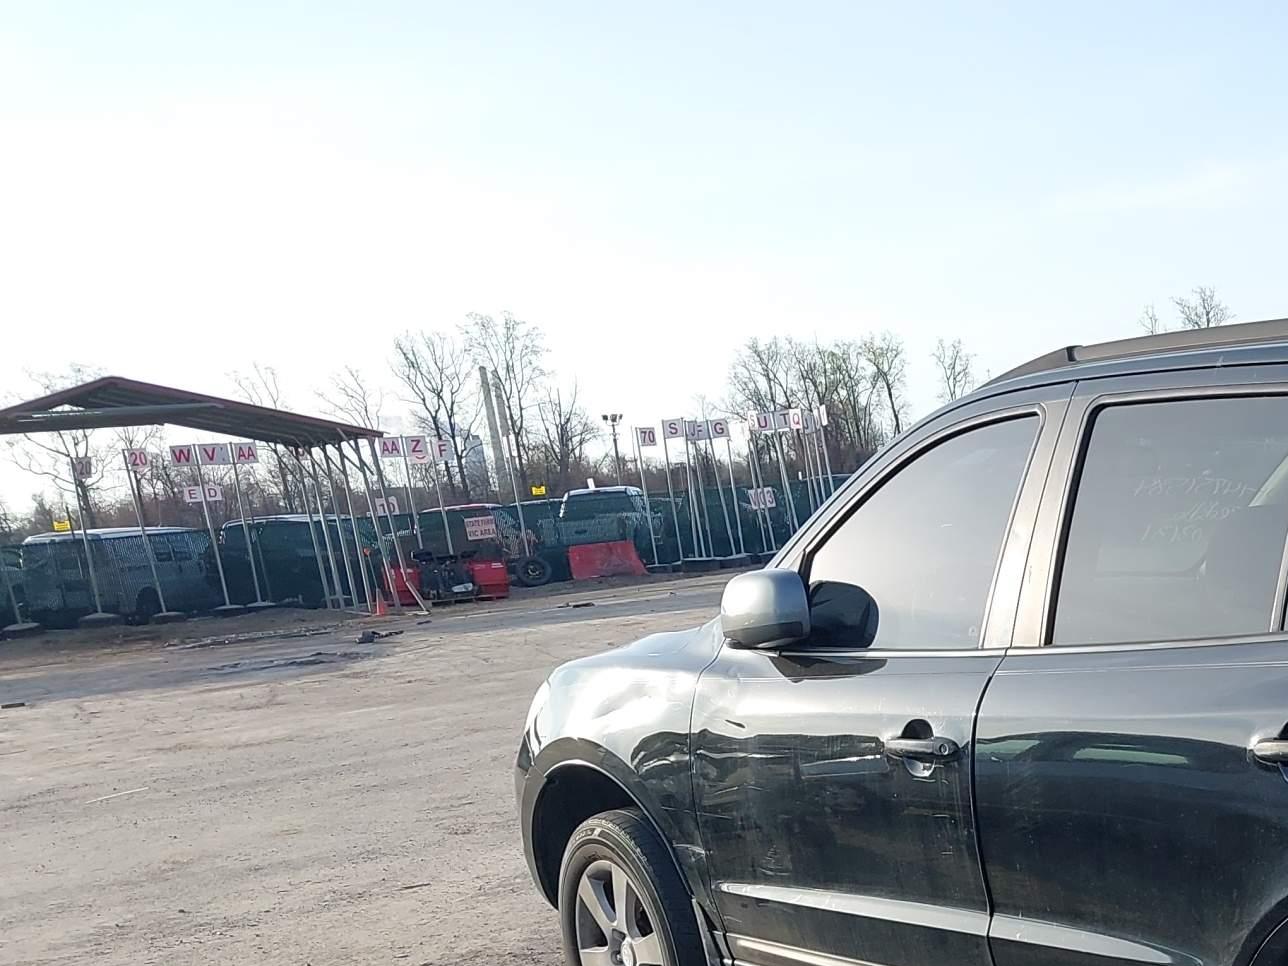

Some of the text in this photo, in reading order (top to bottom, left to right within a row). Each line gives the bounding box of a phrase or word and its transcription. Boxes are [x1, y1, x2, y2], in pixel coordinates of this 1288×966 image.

[757, 415, 769, 429] U
[779, 412, 789, 426] T
[792, 412, 801, 425] Q
[668, 422, 679, 435] S
[713, 422, 725, 435] G
[640, 430, 656, 444] 70
[382, 440, 400, 455] AA
[410, 439, 423, 453] Z
[438, 443, 447, 458] F
[129, 451, 148, 466] 20
[172, 448, 191, 463] W
[203, 447, 216, 461] V
[237, 446, 256, 461] AA
[188, 488, 198, 500] E
[208, 487, 217, 498] D
